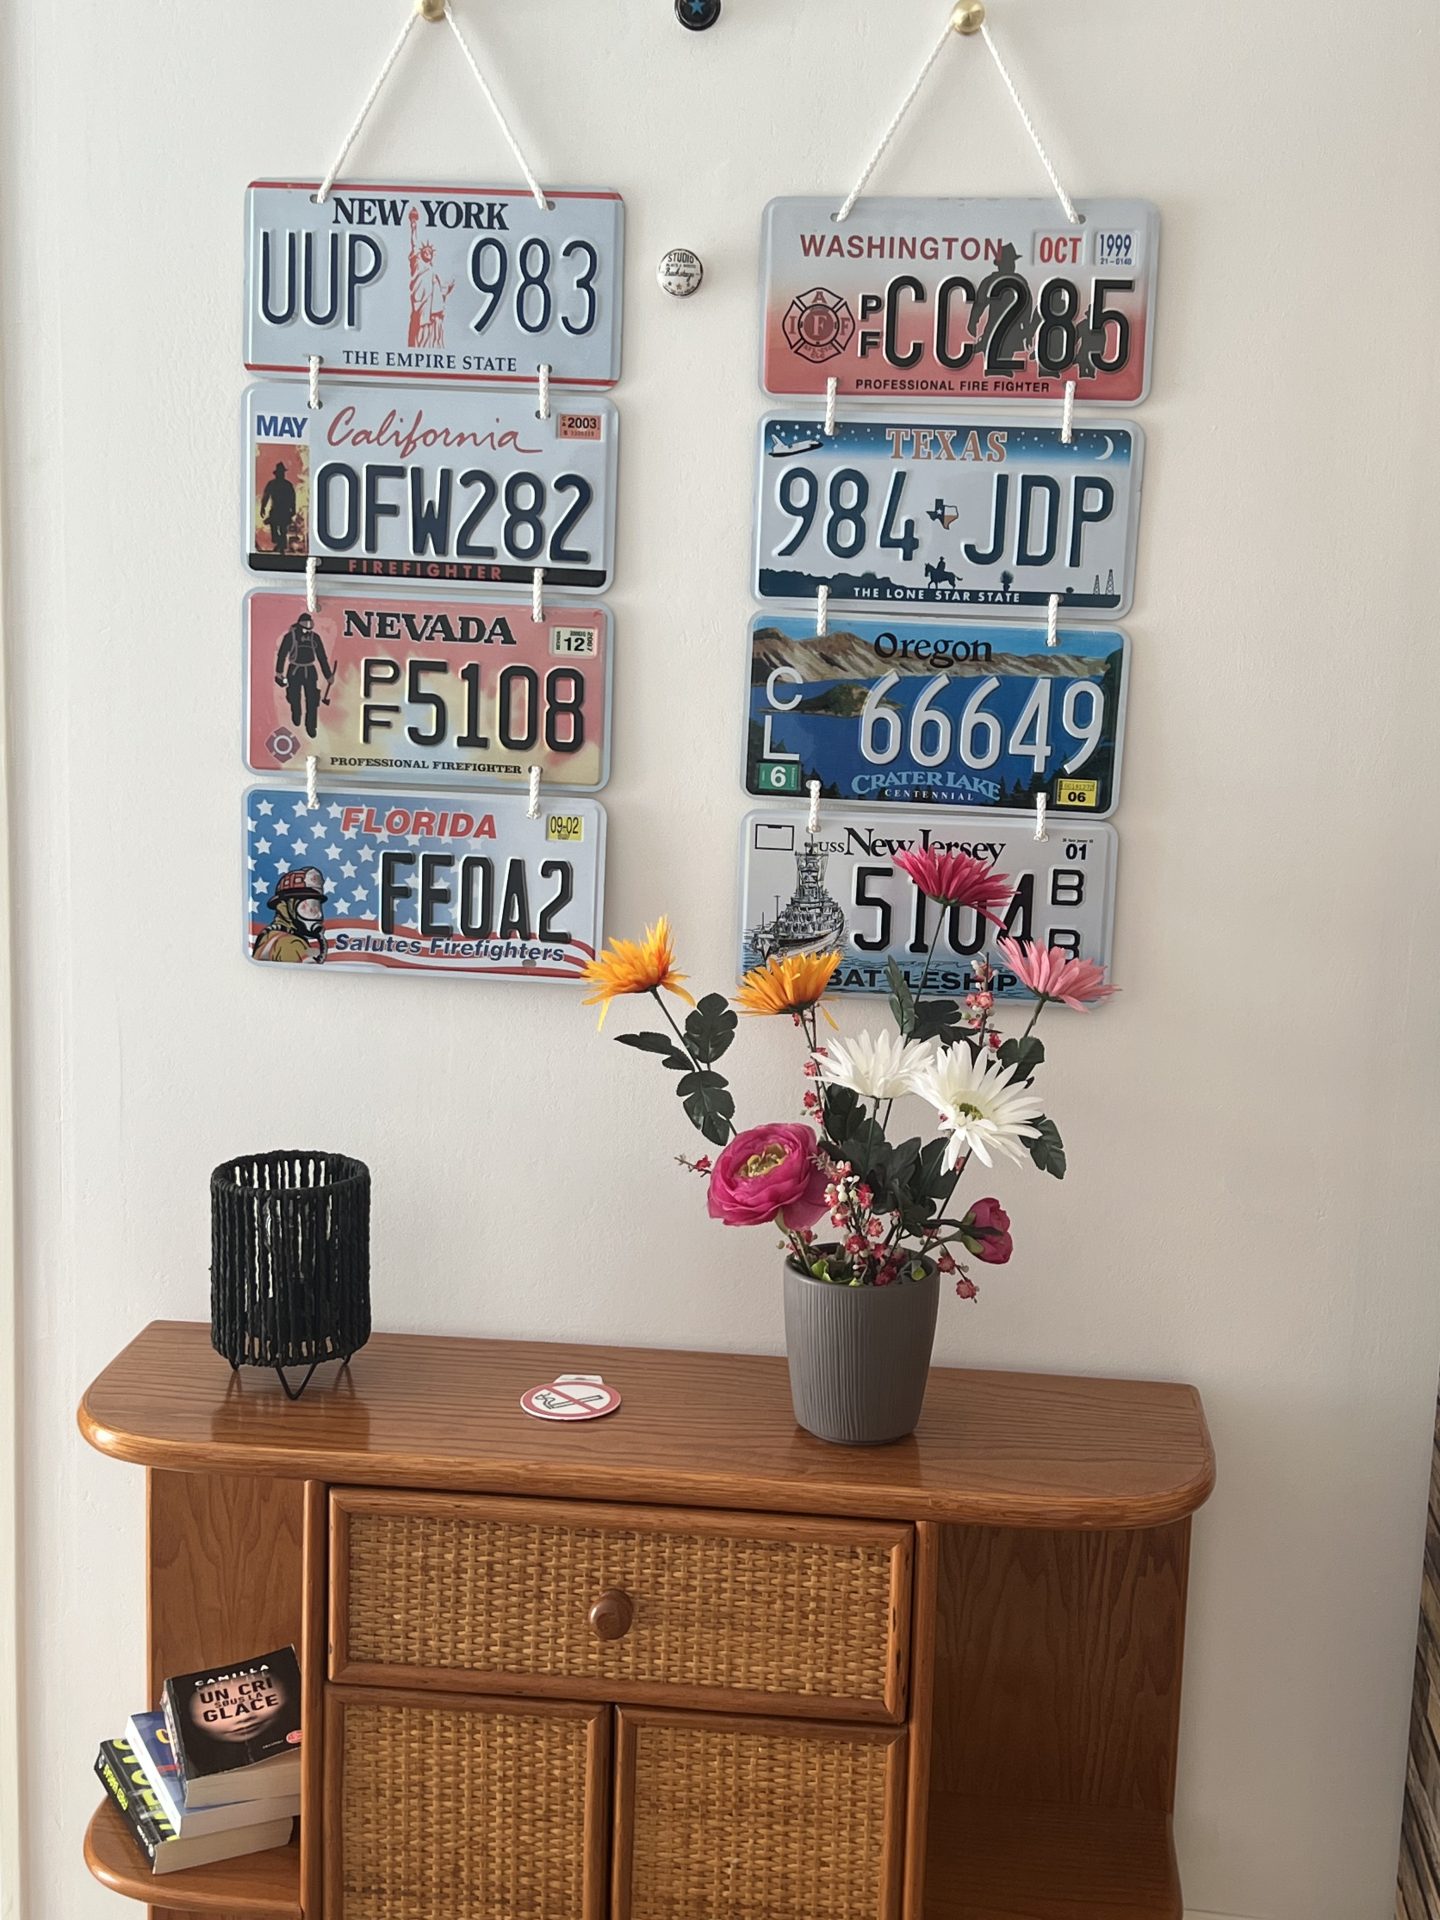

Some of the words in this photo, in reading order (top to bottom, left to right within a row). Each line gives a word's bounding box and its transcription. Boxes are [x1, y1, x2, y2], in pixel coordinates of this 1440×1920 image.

[332, 198, 409, 225] NEW
[420, 200, 510, 230] YORK
[799, 234, 1003, 261] WASHINGTON
[1039, 236, 1082, 264] OCT
[1100, 233, 1132, 257] 1999
[261, 231, 383, 328] UUP
[471, 237, 598, 335] 983
[883, 274, 1136, 372] CC285
[343, 350, 380, 366] THE
[386, 352, 457, 369] EMPIRE
[462, 354, 518, 372] STATE
[855, 378, 956, 392] PROFESSIONAL
[959, 379, 990, 392] FIRE
[993, 380, 1051, 393] FIGHTER
[255, 414, 309, 438] MAY
[326, 405, 543, 458] California
[567, 417, 597, 429] 2003
[885, 427, 1009, 463] TEXAS
[777, 466, 920, 561] 984
[963, 474, 1115, 568] JDP
[348, 559, 503, 581] FIREFIGHTER
[853, 586, 880, 598] THE
[886, 586, 926, 600] LONE
[935, 589, 971, 602] STAR
[977, 590, 1021, 603] STATE
[343, 610, 517, 645] NEVADA
[563, 636, 586, 652] 12
[873, 632, 993, 668] Oregon
[406, 660, 585, 753] 5108
[860, 670, 1105, 776] 66649
[330, 757, 430, 771] PROFESSIONAL
[433, 760, 523, 775] FIREFIGHTER
[770, 765, 787, 788] 6
[851, 770, 944, 795] CRATER
[945, 773, 1001, 802] LAKE
[884, 788, 975, 801] CENTENNIAL
[1067, 791, 1087, 803] 06
[341, 807, 498, 840] FLORIDA
[550, 815, 579, 834] 09-02
[818, 841, 845, 853] USS
[843, 827, 915, 857] New
[1065, 843, 1087, 861] 01
[335, 932, 422, 955] Salutes
[430, 938, 565, 964] Firefighters
[194, 1664, 270, 1687] CAMILLA
[200, 1688, 230, 1704] UN
[238, 1677, 274, 1696] CRI
[202, 1693, 280, 1723] GLACE
[214, 1696, 245, 1709] SOUS
[248, 1692, 264, 1702] LA
